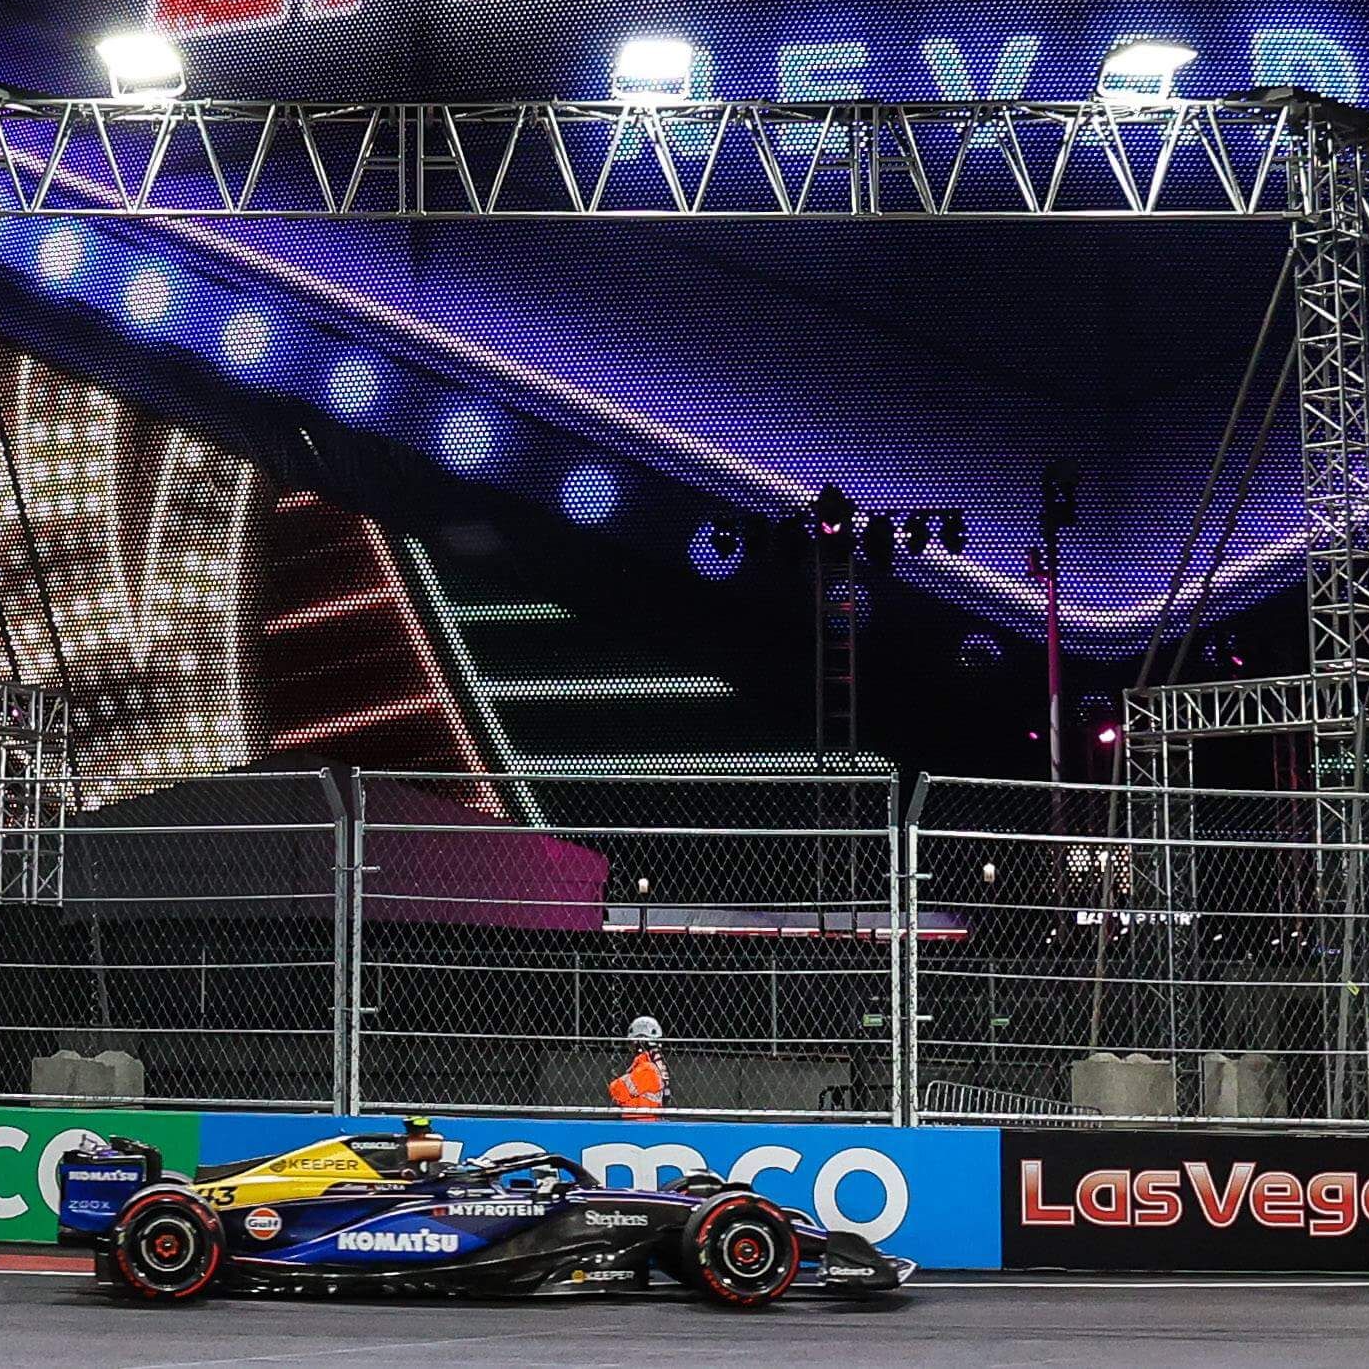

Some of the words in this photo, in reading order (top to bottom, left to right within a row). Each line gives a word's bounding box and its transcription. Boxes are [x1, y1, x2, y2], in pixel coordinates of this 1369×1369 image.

[288, 1158, 359, 1171] KEEPER
[448, 1204, 545, 1217] MYPROTEIN
[247, 1217, 279, 1229] Gulf
[584, 1210, 648, 1229] Stephens
[337, 1228, 459, 1253] KOMATSU
